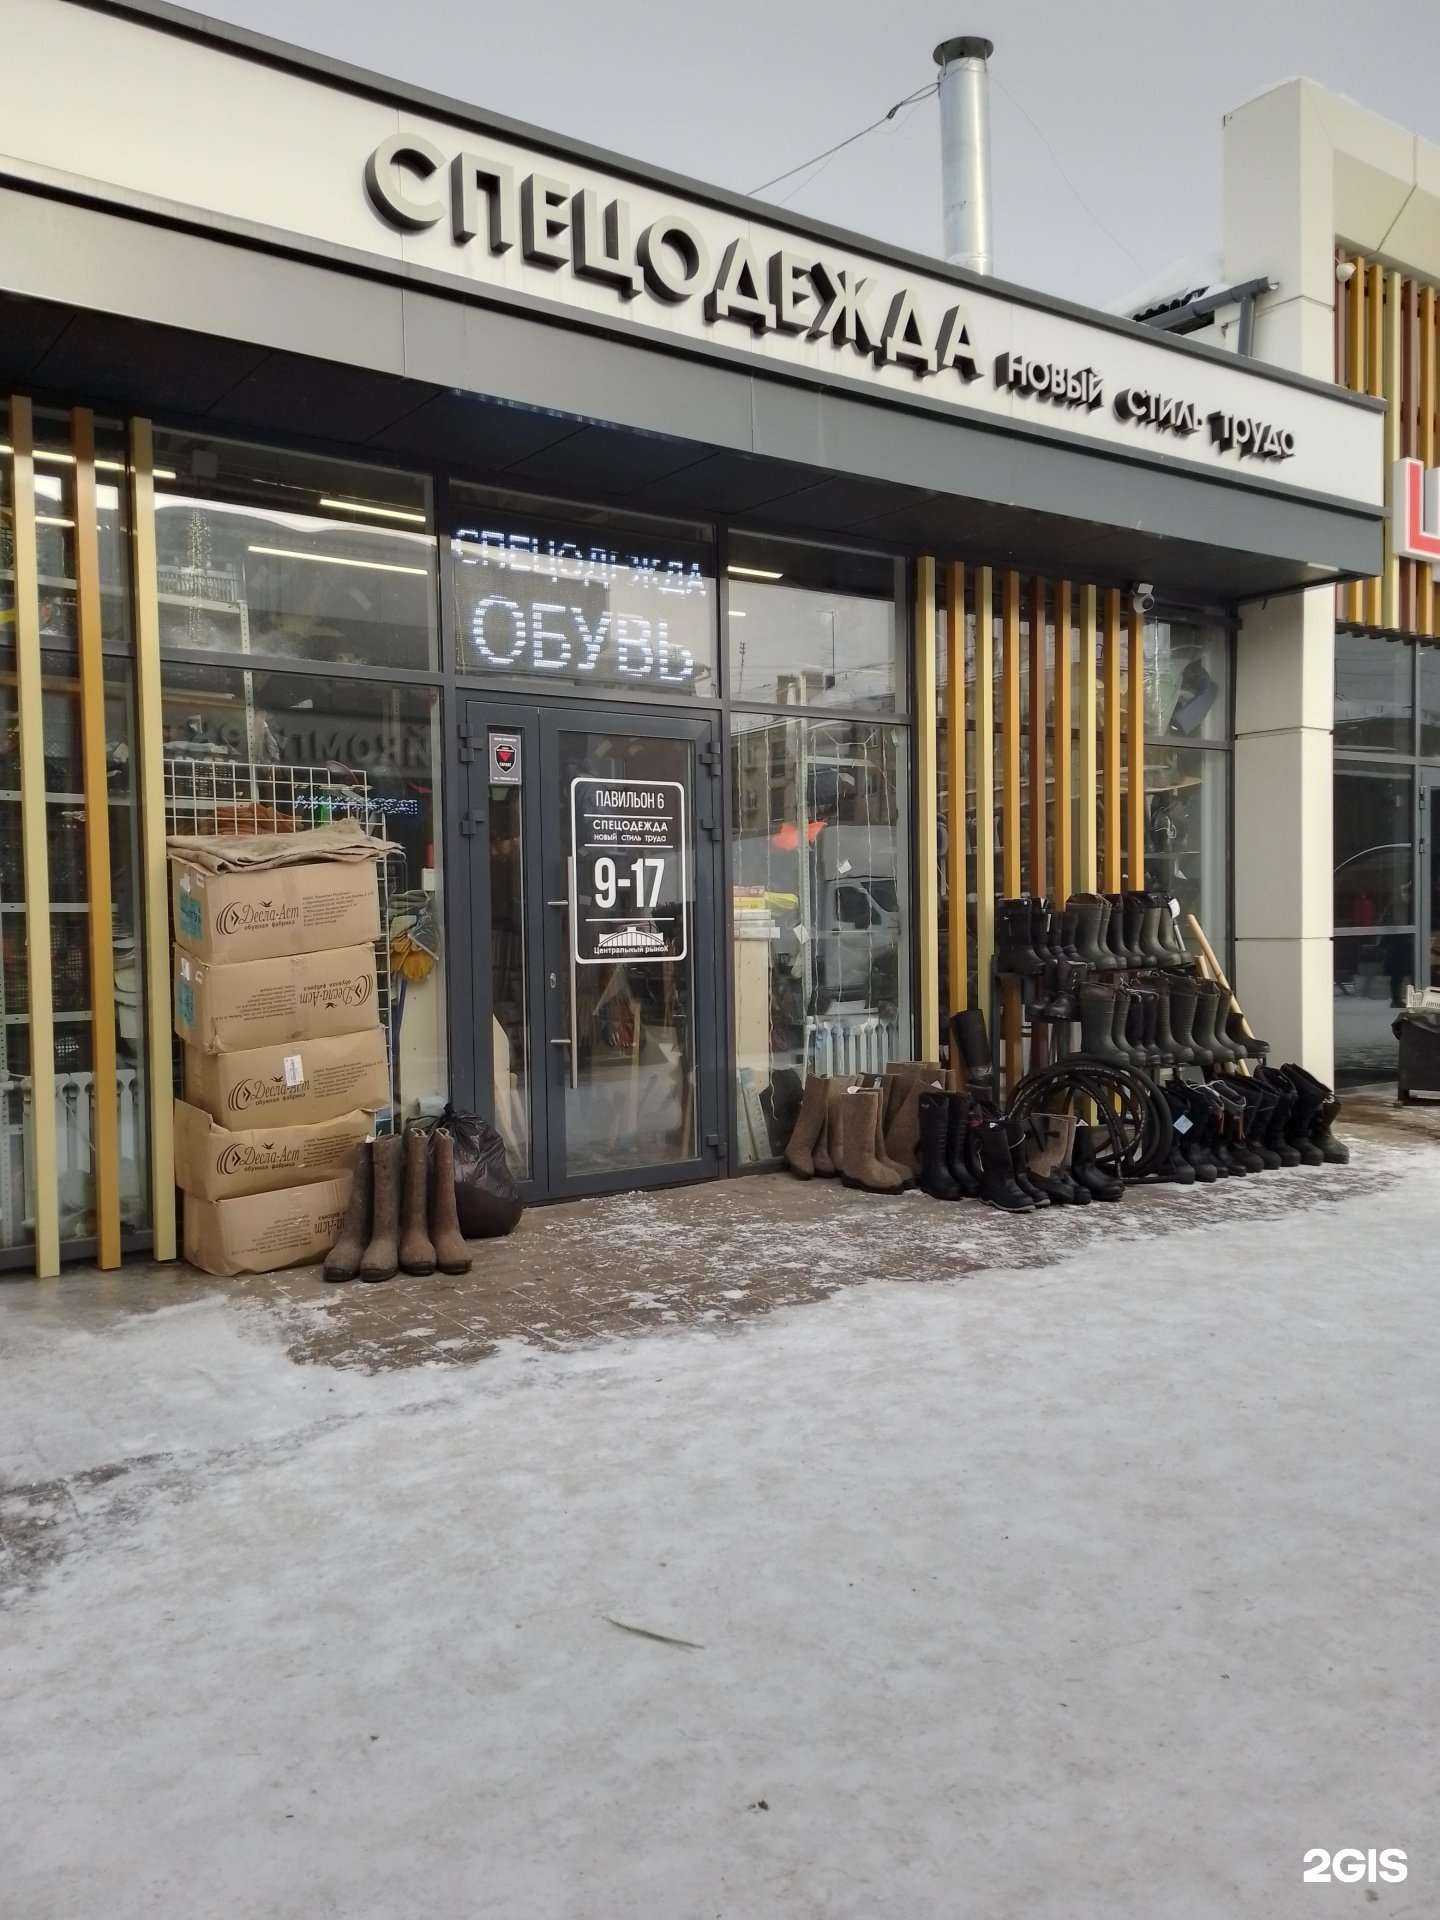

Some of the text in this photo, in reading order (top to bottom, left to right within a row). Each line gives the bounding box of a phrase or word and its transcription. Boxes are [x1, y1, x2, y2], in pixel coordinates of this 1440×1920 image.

[366, 132, 982, 381] СПЕЦОДЕЖДА
[473, 594, 695, 682] ОБУВЬ
[596, 790, 665, 809] ПАВИЛЬОН 6
[592, 819, 668, 833] СПЕЦОДЕЖДА
[594, 856, 665, 909] 9-17
[593, 944, 669, 956] Центральный рынок
